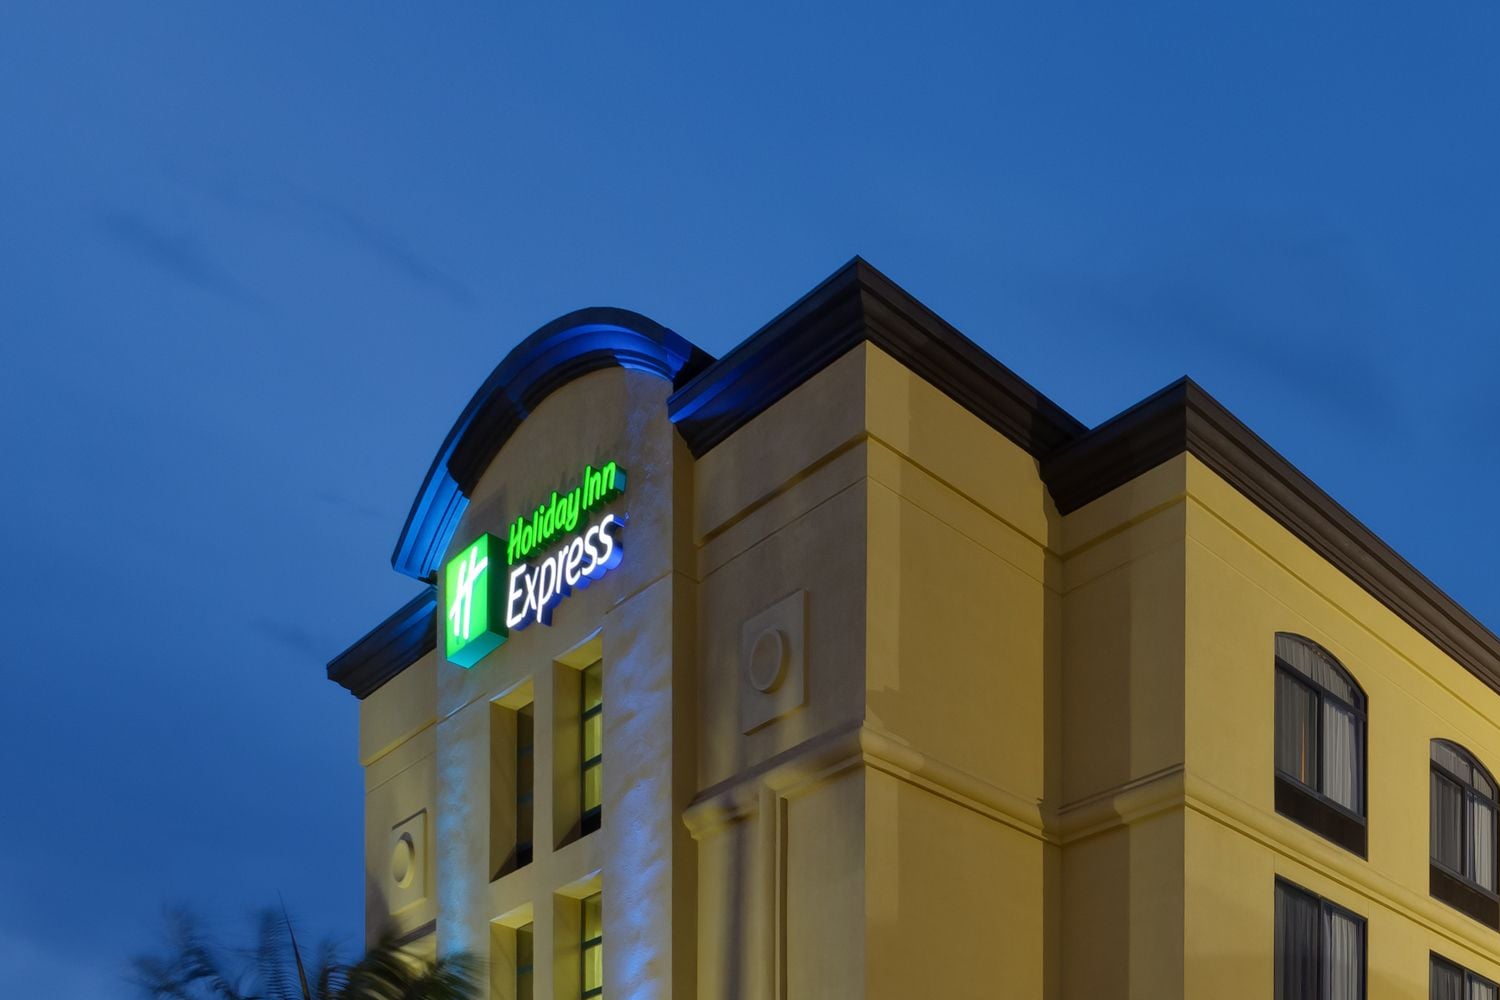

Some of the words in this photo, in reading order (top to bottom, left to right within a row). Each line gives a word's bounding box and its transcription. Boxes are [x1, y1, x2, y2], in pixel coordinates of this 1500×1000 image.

[508, 487, 581, 565] Holiday
[583, 461, 616, 510] Inn
[506, 514, 615, 628] Express
